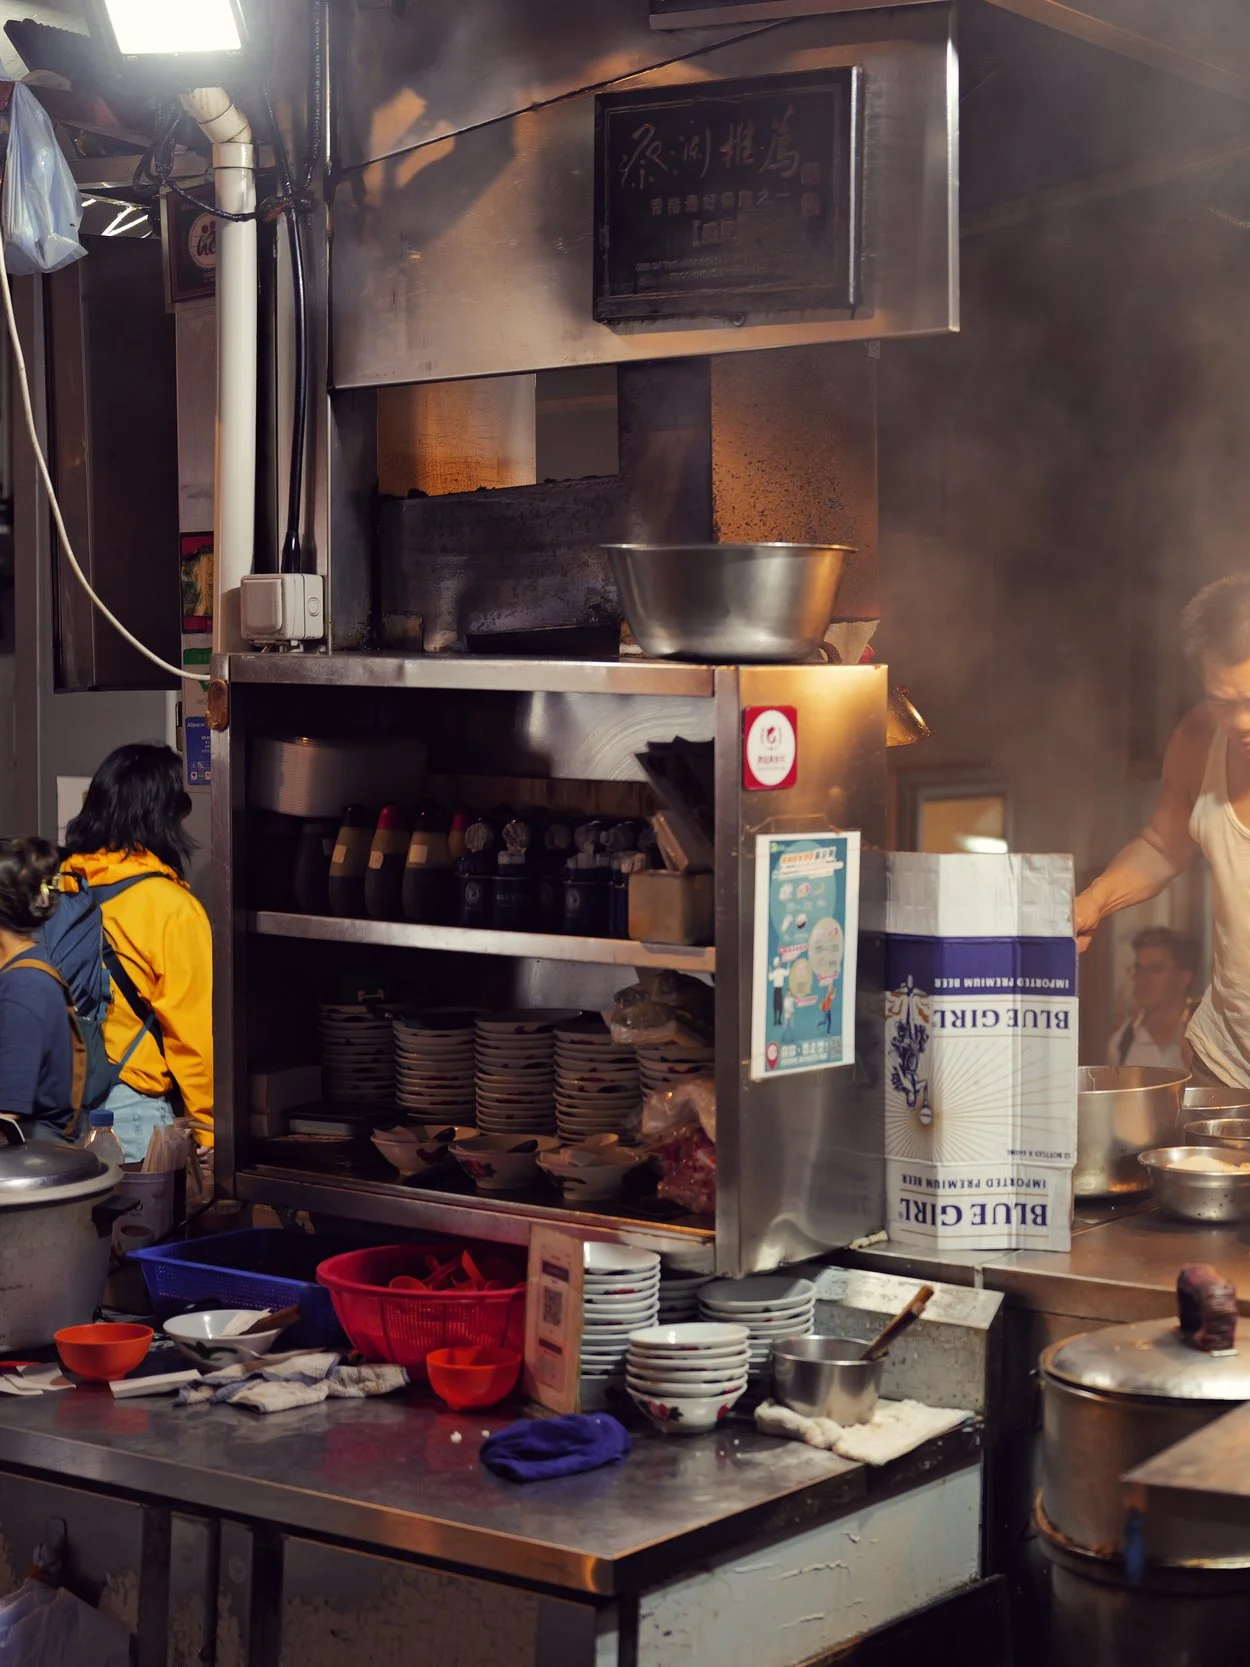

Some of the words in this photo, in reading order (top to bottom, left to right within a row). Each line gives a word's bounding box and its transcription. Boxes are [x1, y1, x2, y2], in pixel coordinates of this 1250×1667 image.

[933, 977, 961, 989] BEER
[963, 976, 1015, 988] PREMIUM
[1016, 977, 1070, 989] IMPORTED
[933, 1009, 1000, 1029] GIRL
[1006, 1009, 1070, 1030] BLUE
[1034, 1151, 1063, 1160] BOTTLES
[901, 1174, 923, 1187] BEER
[925, 1176, 981, 1189] PREMIUM
[986, 1177, 1047, 1189] IMPORTED
[899, 1197, 963, 1227] GIRL
[971, 1202, 1049, 1227] BLUE
